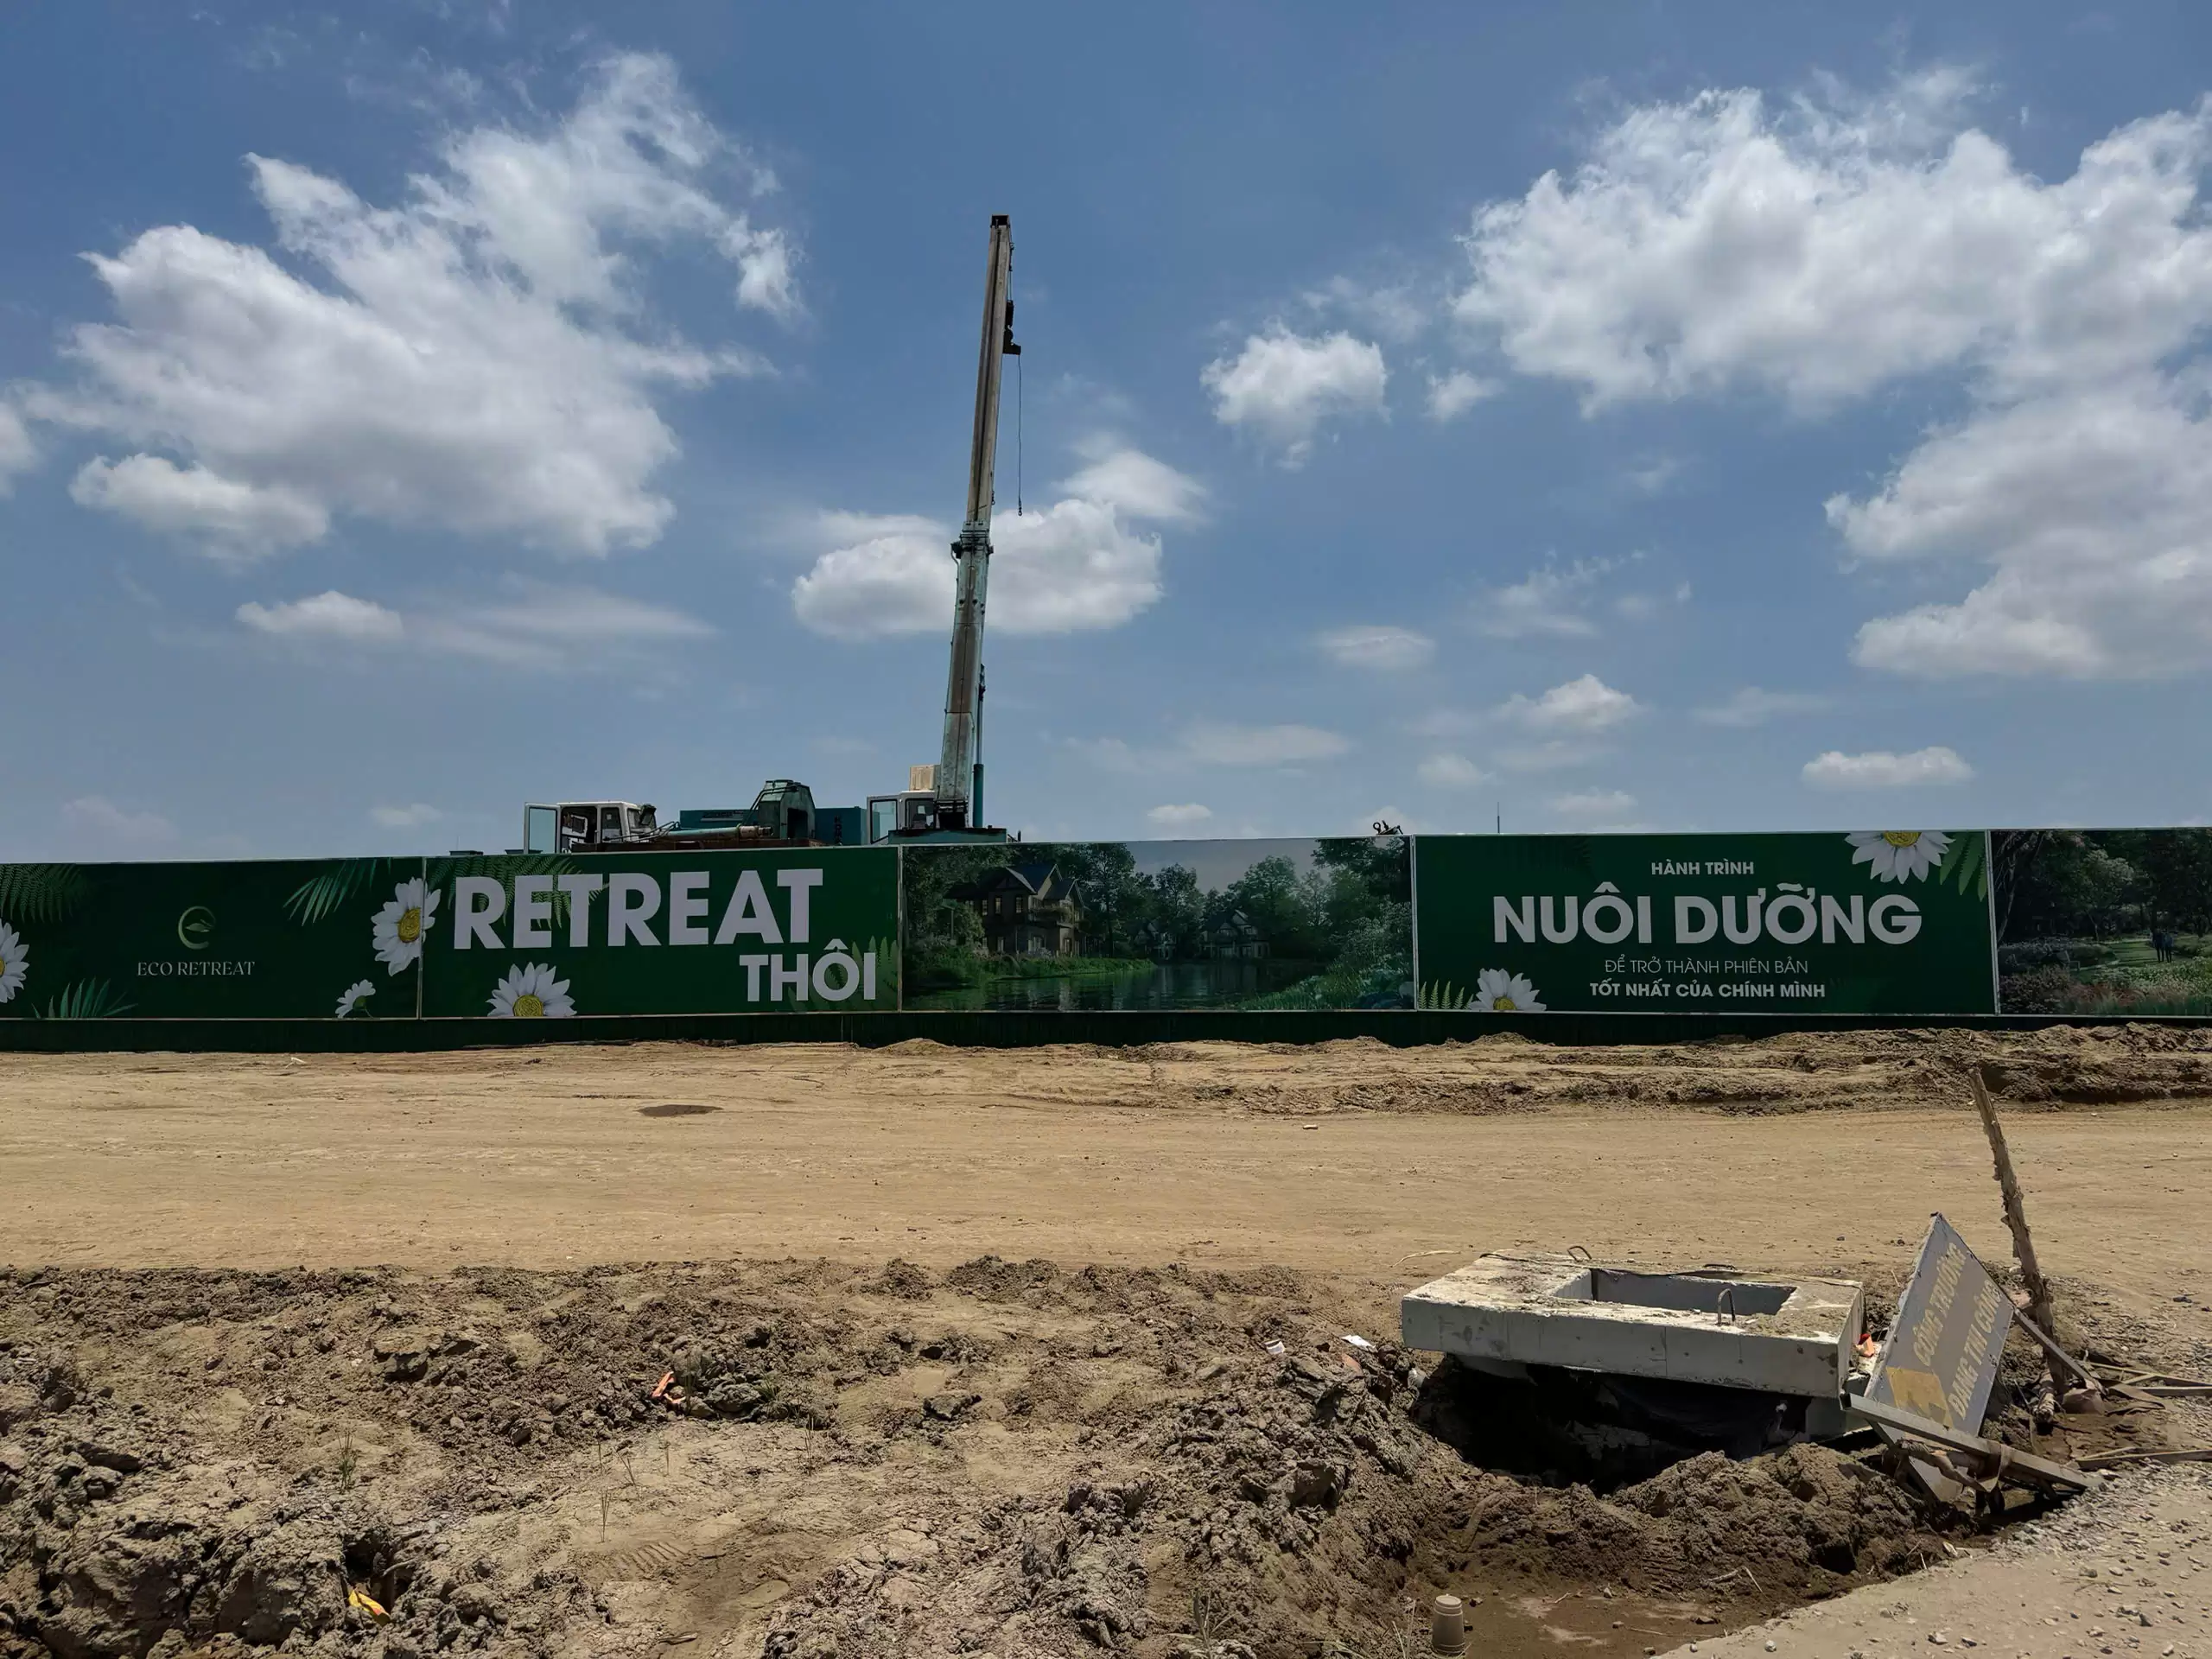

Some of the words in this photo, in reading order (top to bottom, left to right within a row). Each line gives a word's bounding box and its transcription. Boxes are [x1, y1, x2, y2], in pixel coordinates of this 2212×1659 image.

[1651, 859, 1700, 875] HÀNH
[1705, 858, 1755, 875] TRÌNH
[454, 868, 823, 949] RETREAT
[1493, 881, 1652, 944] NUÔI
[1675, 882, 1923, 944] DƯỠNG
[137, 962, 173, 976] ECO
[177, 961, 256, 976] RETREAT
[739, 938, 876, 1001] THÔI
[1590, 977, 1620, 996] TỐT
[1625, 977, 1671, 997] NHẤT
[1675, 979, 1713, 997] CỦA
[1718, 980, 1775, 998] CHÍNH
[1780, 980, 1826, 998] MÌNH
[1605, 954, 1625, 974] ĐỂ
[1630, 957, 1662, 974] TRỞ
[1665, 957, 1719, 974] THÀNH
[1724, 957, 1770, 974] PHIÊN
[1775, 956, 1808, 974] BẢN
[1974, 1279, 2002, 1334] CÔNG
[1912, 1308, 1944, 1367] CÔNG
